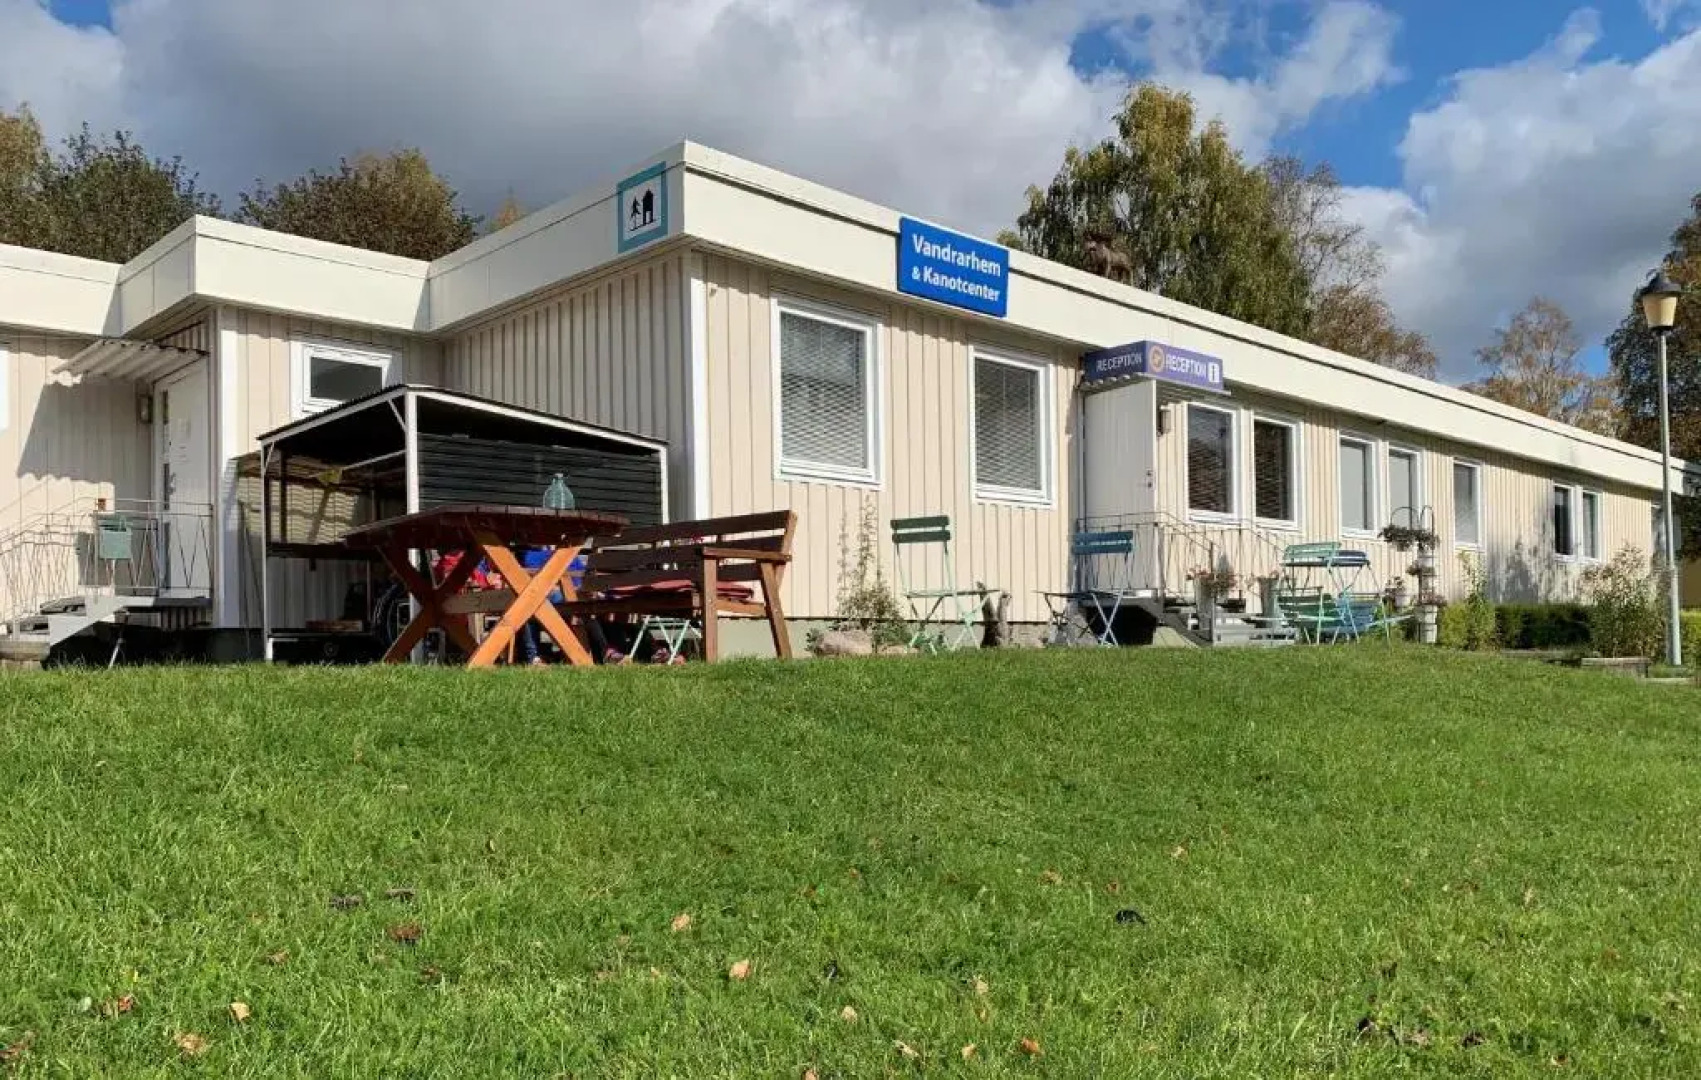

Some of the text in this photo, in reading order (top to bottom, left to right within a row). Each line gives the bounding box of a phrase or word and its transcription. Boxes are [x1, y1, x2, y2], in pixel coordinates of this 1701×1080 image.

[912, 233, 1001, 277] Vandrarhem
[911, 265, 1001, 302] & Kanotcenter
[1096, 353, 1142, 372] RECEPTION
[1166, 354, 1207, 379] RECEPTION
